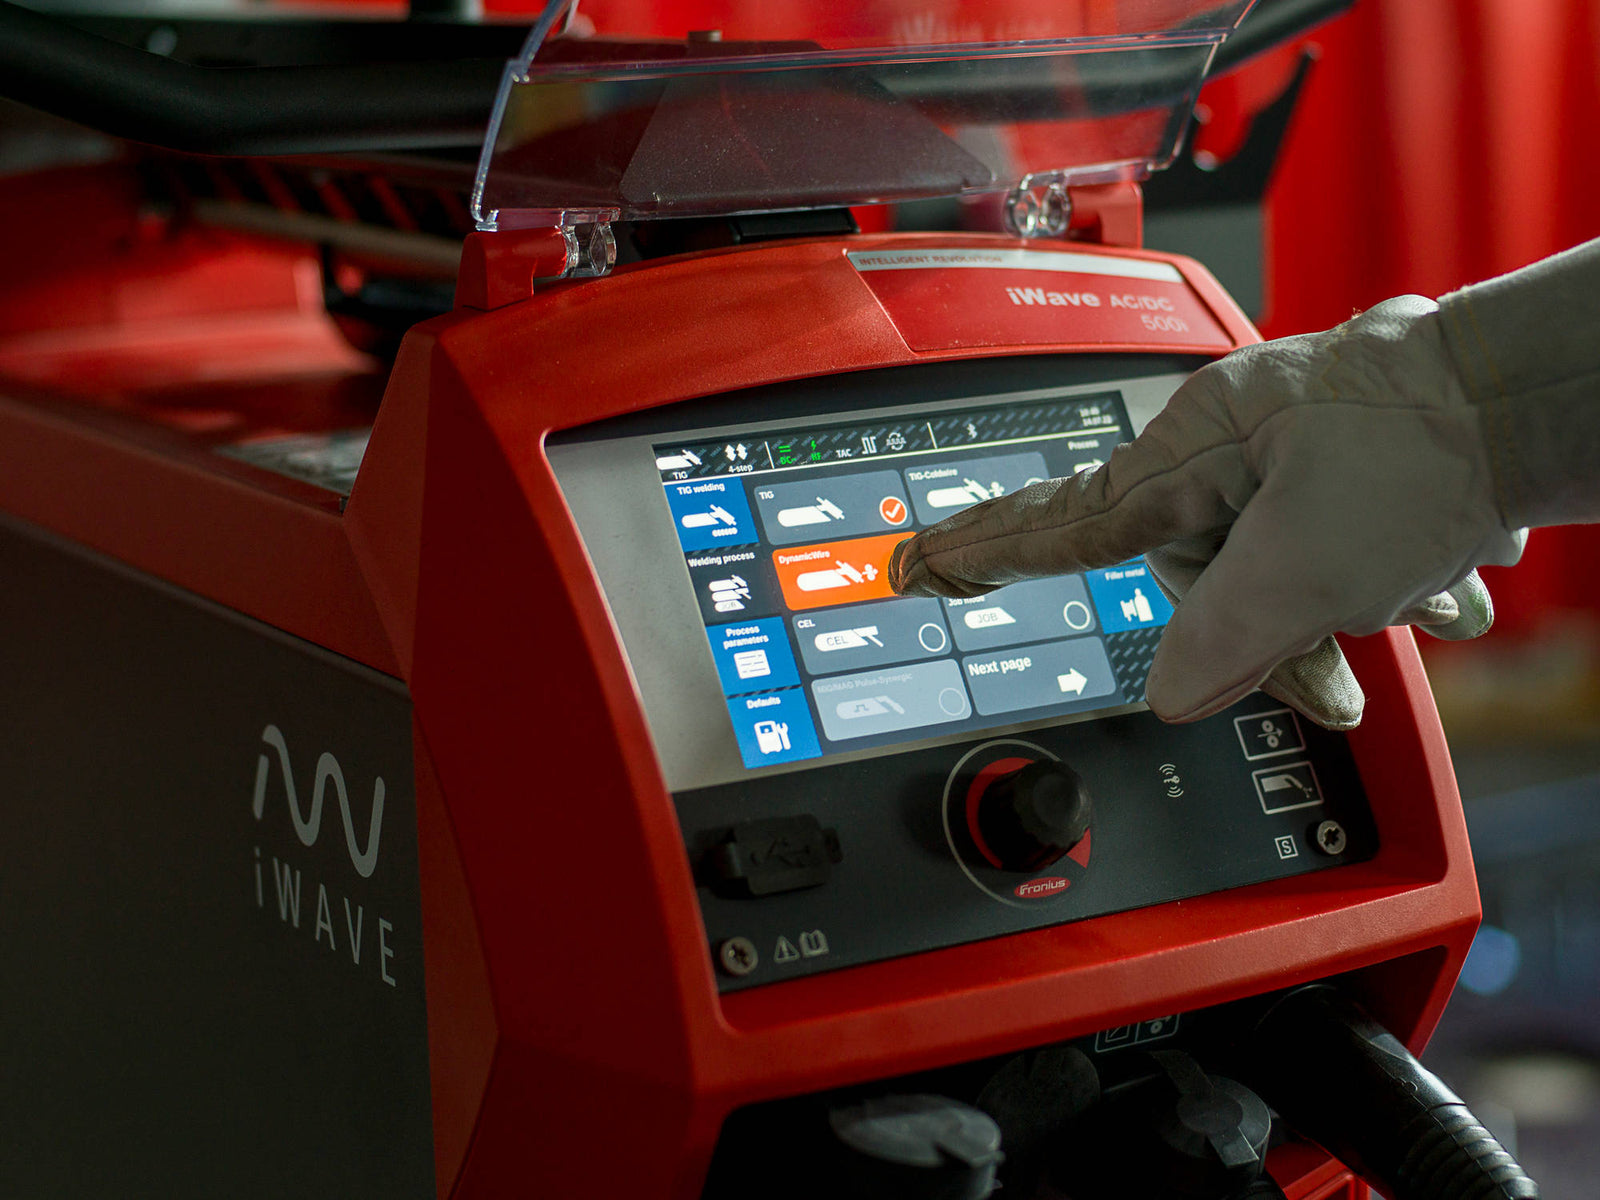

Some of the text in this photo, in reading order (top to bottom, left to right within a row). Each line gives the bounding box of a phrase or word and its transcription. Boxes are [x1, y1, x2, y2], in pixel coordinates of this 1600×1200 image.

[858, 254, 1003, 267] INTELLIGENT REVOLUTION
[1006, 287, 1175, 311] iWave AC/DC
[1141, 316, 1188, 332] 500i
[836, 448, 852, 458] TAC
[728, 463, 754, 473] 4-step
[908, 467, 959, 481] TIG-Coldwire
[673, 471, 688, 480] TIG
[677, 482, 725, 495] TIG welding
[759, 491, 774, 500] TIG
[688, 551, 755, 568] Welding process
[778, 549, 830, 564] DynamicWire
[797, 619, 815, 629] CEL
[977, 612, 998, 624] JOB
[725, 624, 759, 637] Process
[723, 634, 769, 650] parameters
[826, 634, 849, 647] CEL
[968, 655, 1031, 677] Next page
[746, 696, 781, 710] Defaults
[1019, 879, 1066, 896] Fronius
[255, 846, 397, 987] iWAVE
